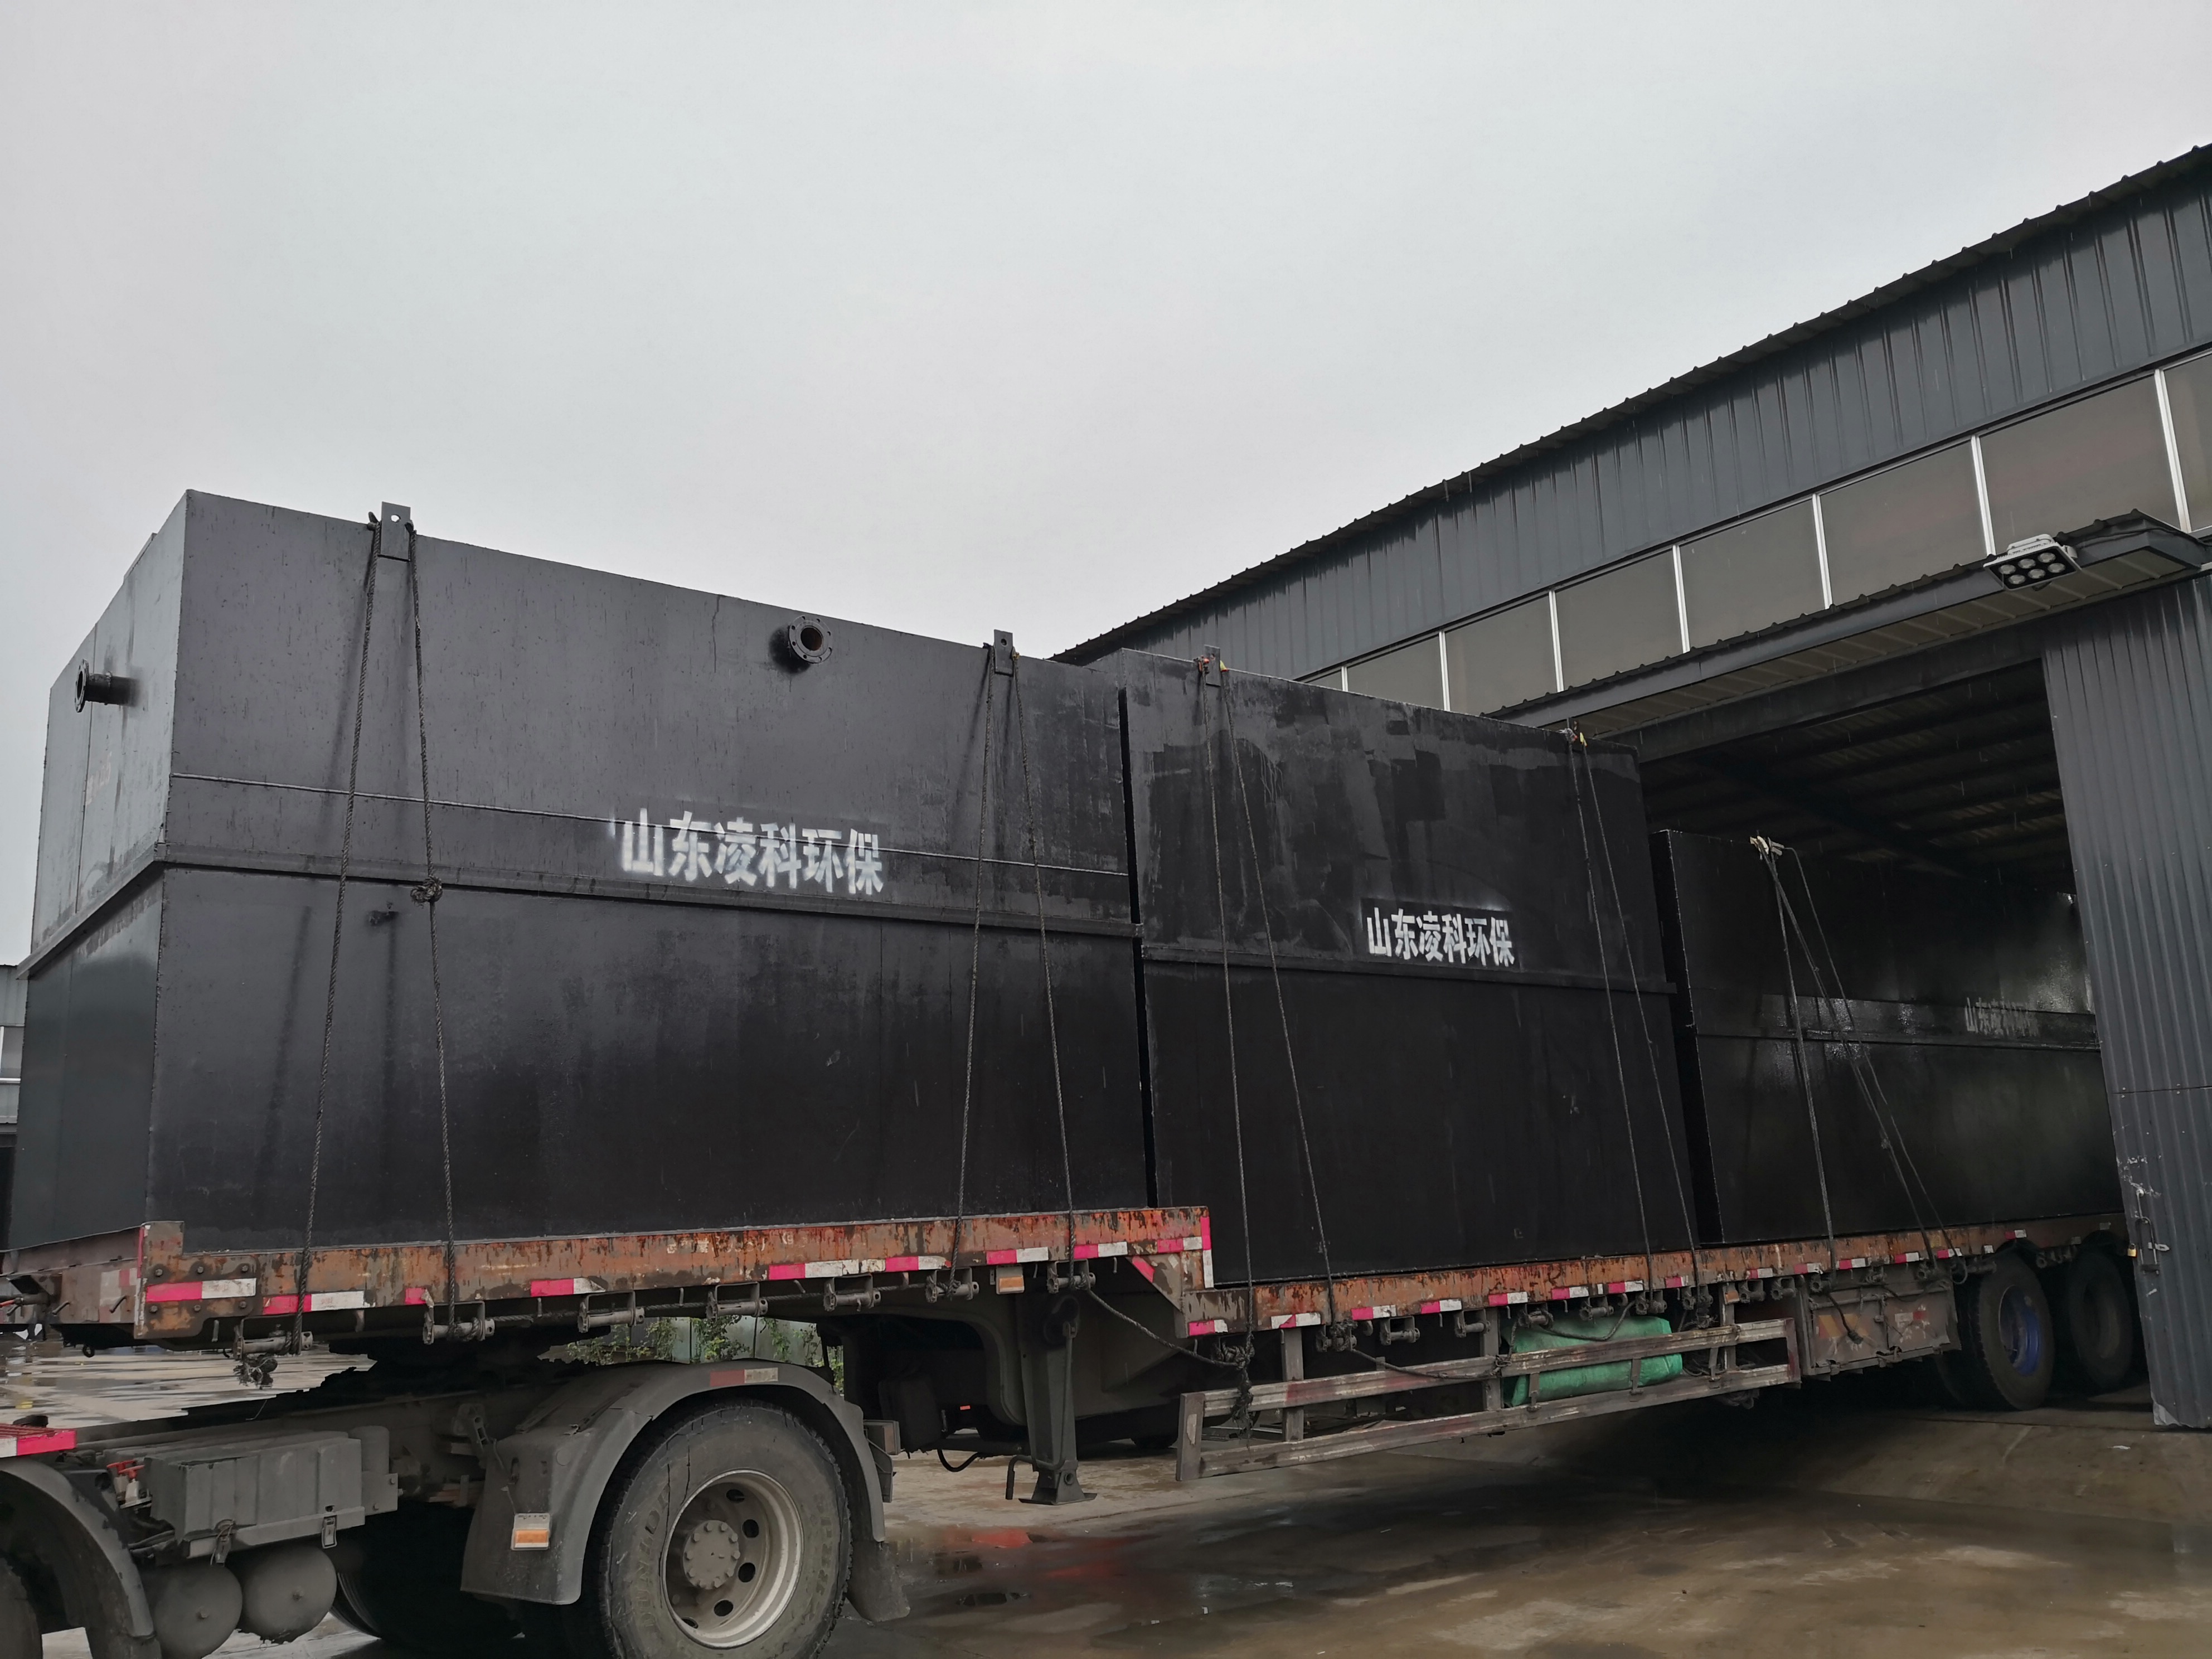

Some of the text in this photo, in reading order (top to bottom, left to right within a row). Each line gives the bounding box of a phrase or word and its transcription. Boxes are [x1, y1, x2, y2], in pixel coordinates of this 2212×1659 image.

[621, 808, 884, 895] 山东凌科环保
[1367, 907, 1515, 967] 山东凌科环保
